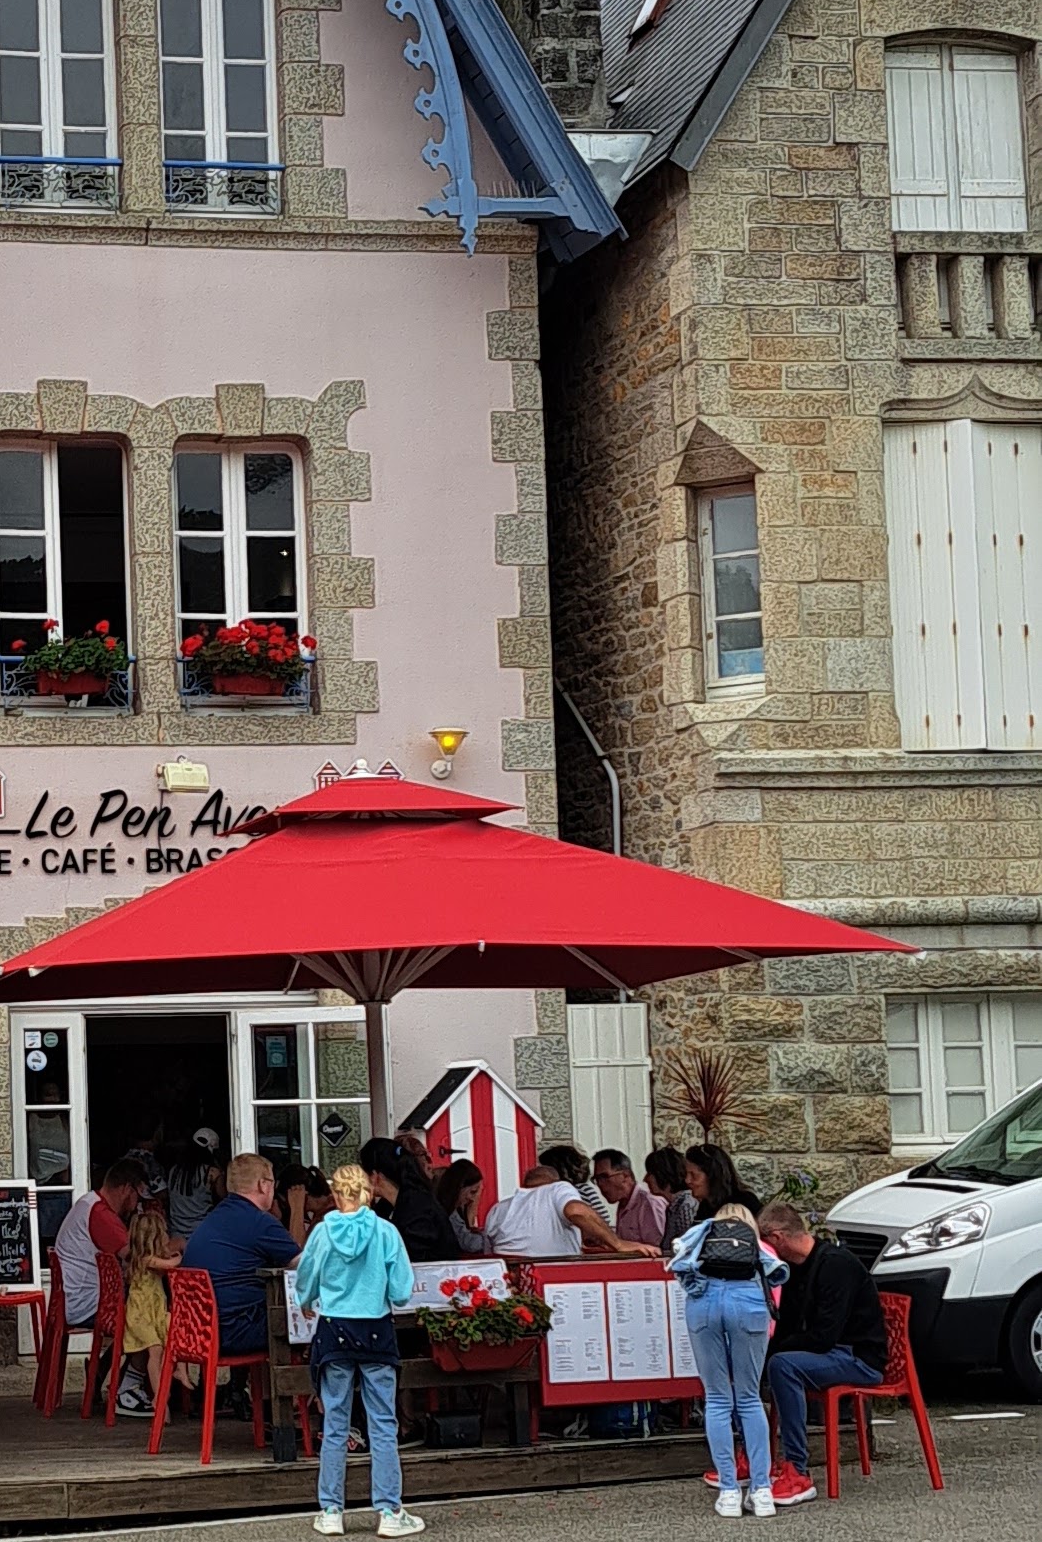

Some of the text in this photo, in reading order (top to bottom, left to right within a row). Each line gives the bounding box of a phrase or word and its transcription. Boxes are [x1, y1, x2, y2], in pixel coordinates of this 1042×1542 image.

[25, 789, 77, 839] Le
[89, 789, 177, 838] Pen
[41, 842, 117, 874] CAFÉ
